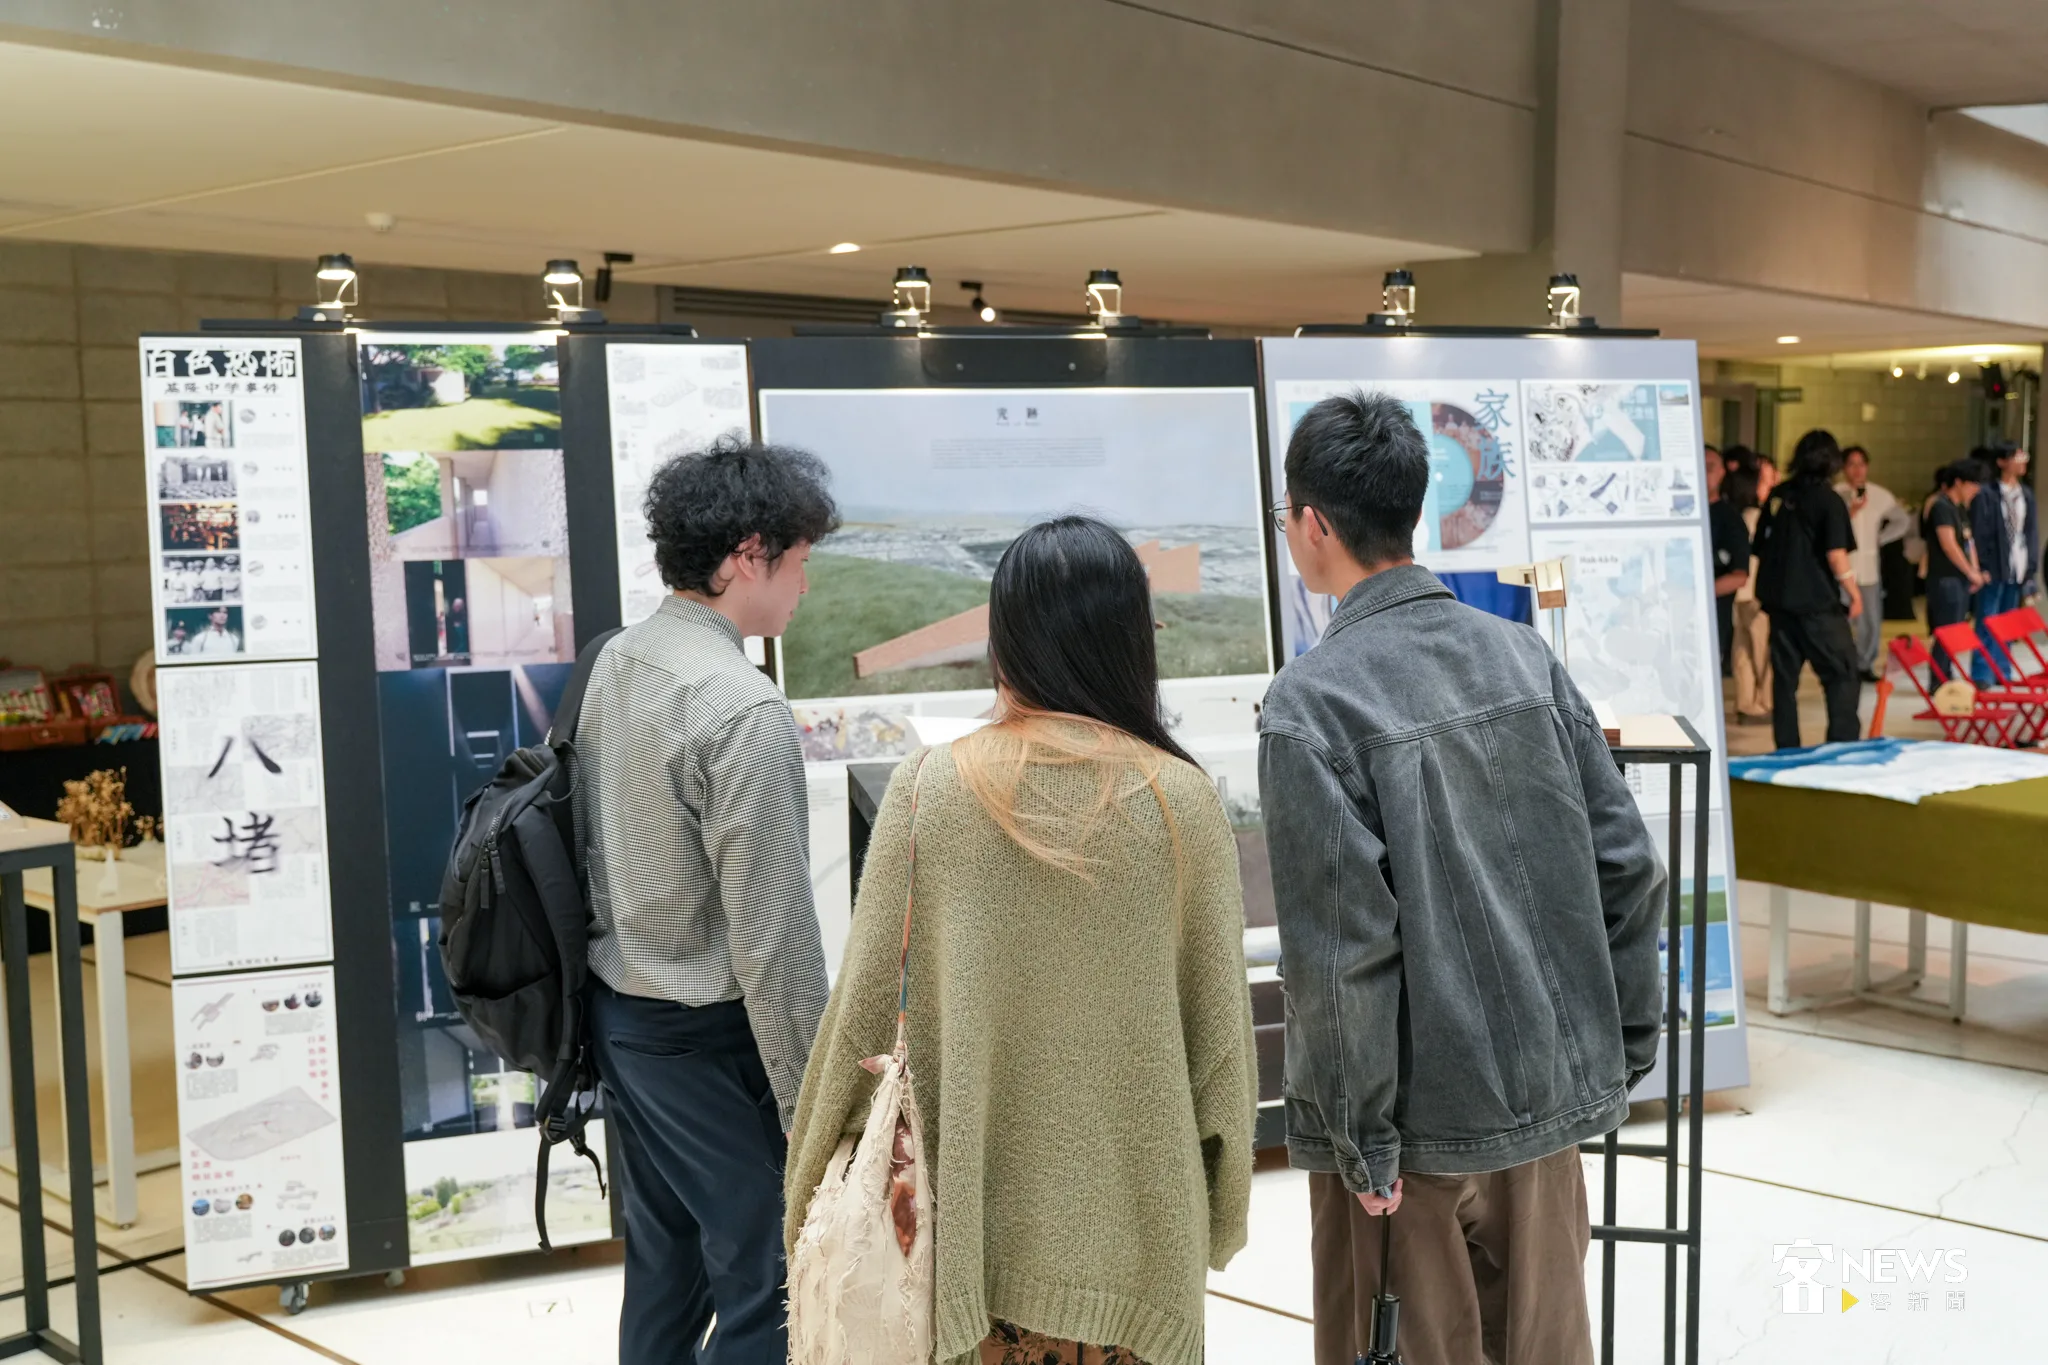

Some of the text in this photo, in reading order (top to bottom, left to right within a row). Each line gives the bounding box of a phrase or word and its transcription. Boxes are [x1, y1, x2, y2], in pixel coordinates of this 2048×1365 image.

[147, 349, 297, 377] 白色恐怖
[1474, 387, 1517, 481] 家族
[207, 735, 282, 874] 八堵
